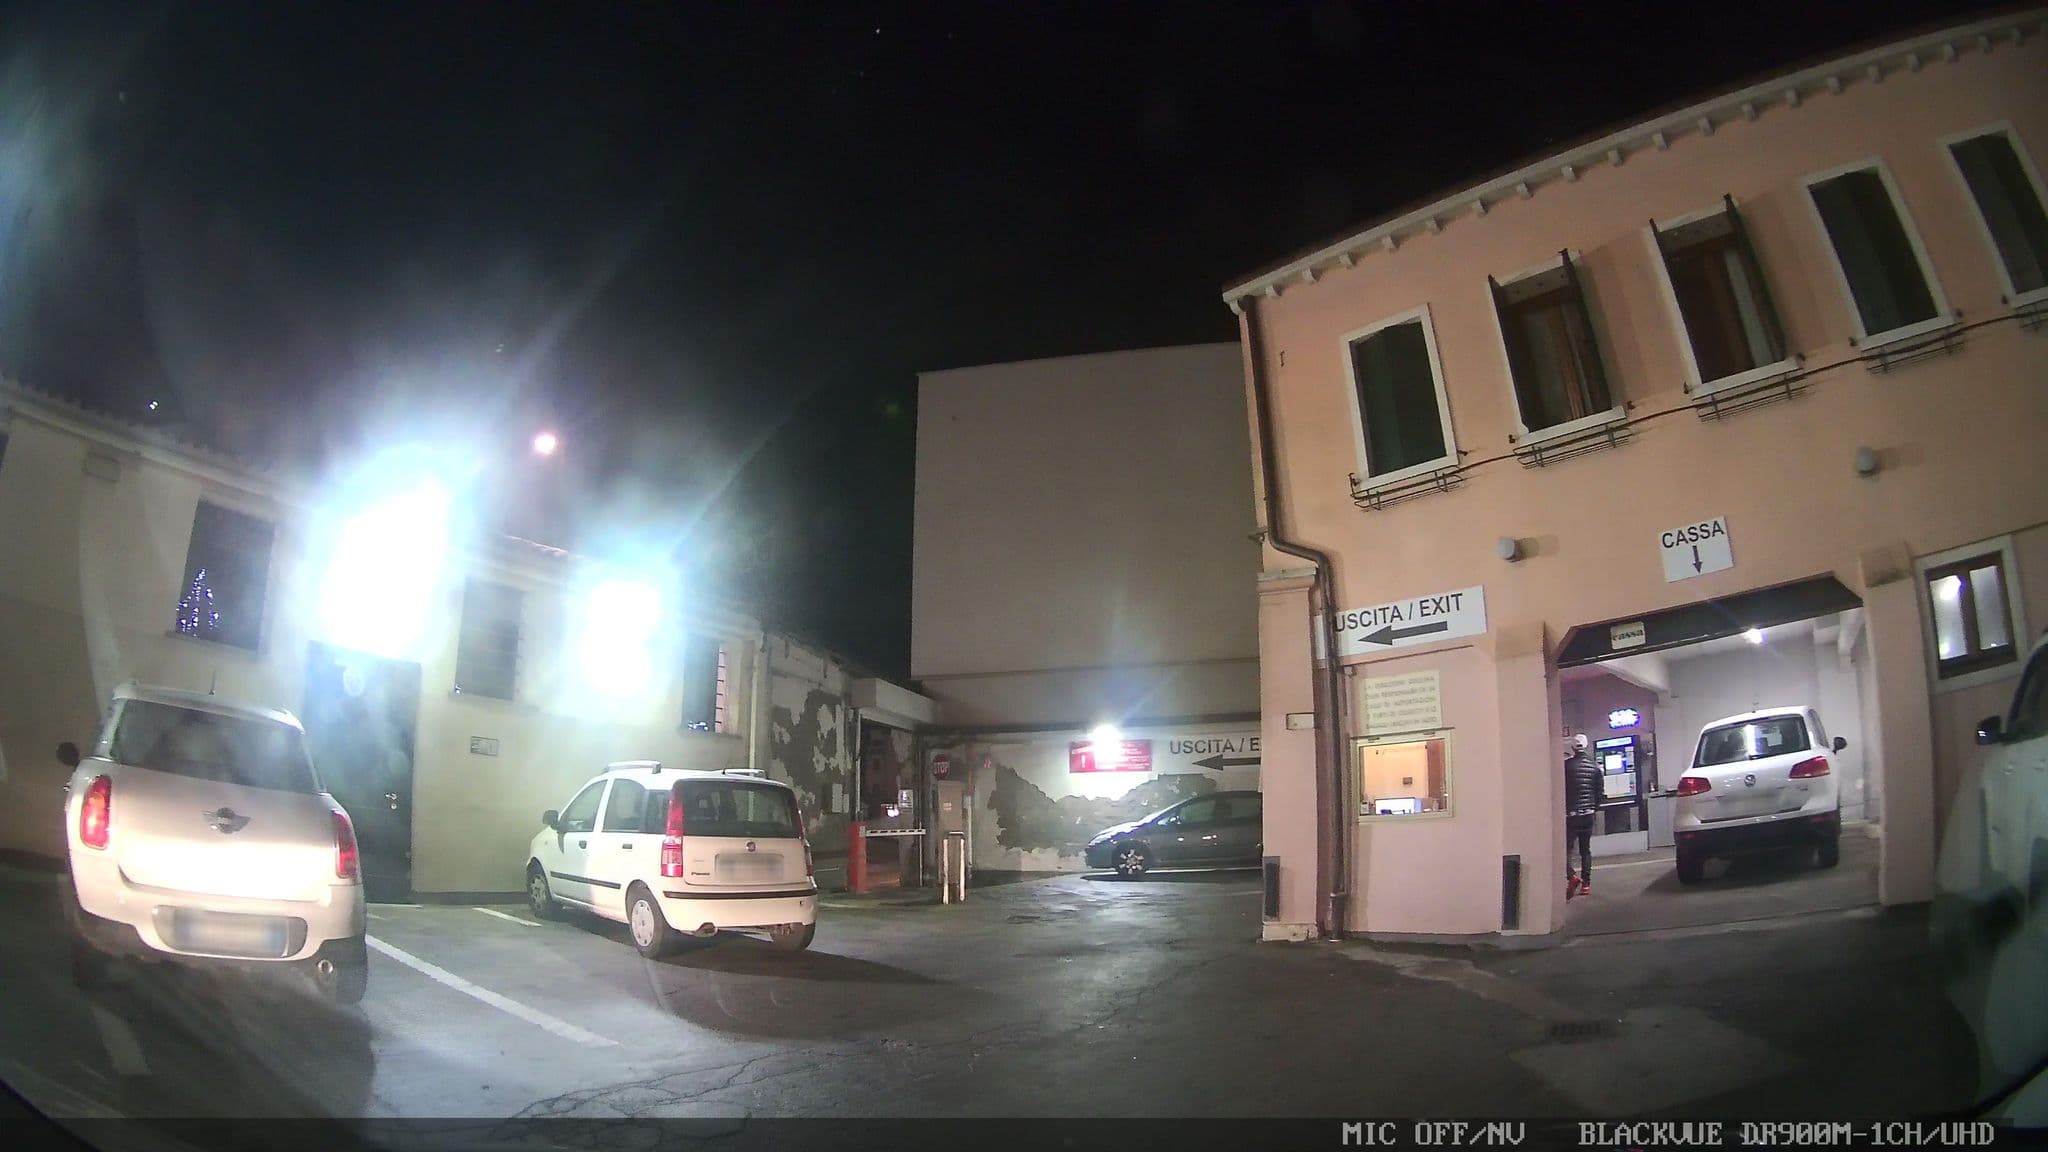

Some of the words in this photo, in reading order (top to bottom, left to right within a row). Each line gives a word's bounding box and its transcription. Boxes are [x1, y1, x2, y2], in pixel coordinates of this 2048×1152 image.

[1662, 520, 1725, 548] CASSA
[1336, 605, 1403, 632] USCITA
[1408, 602, 1413, 620] /
[1420, 593, 1463, 617] EXIT
[1170, 738, 1234, 755] USCITA
